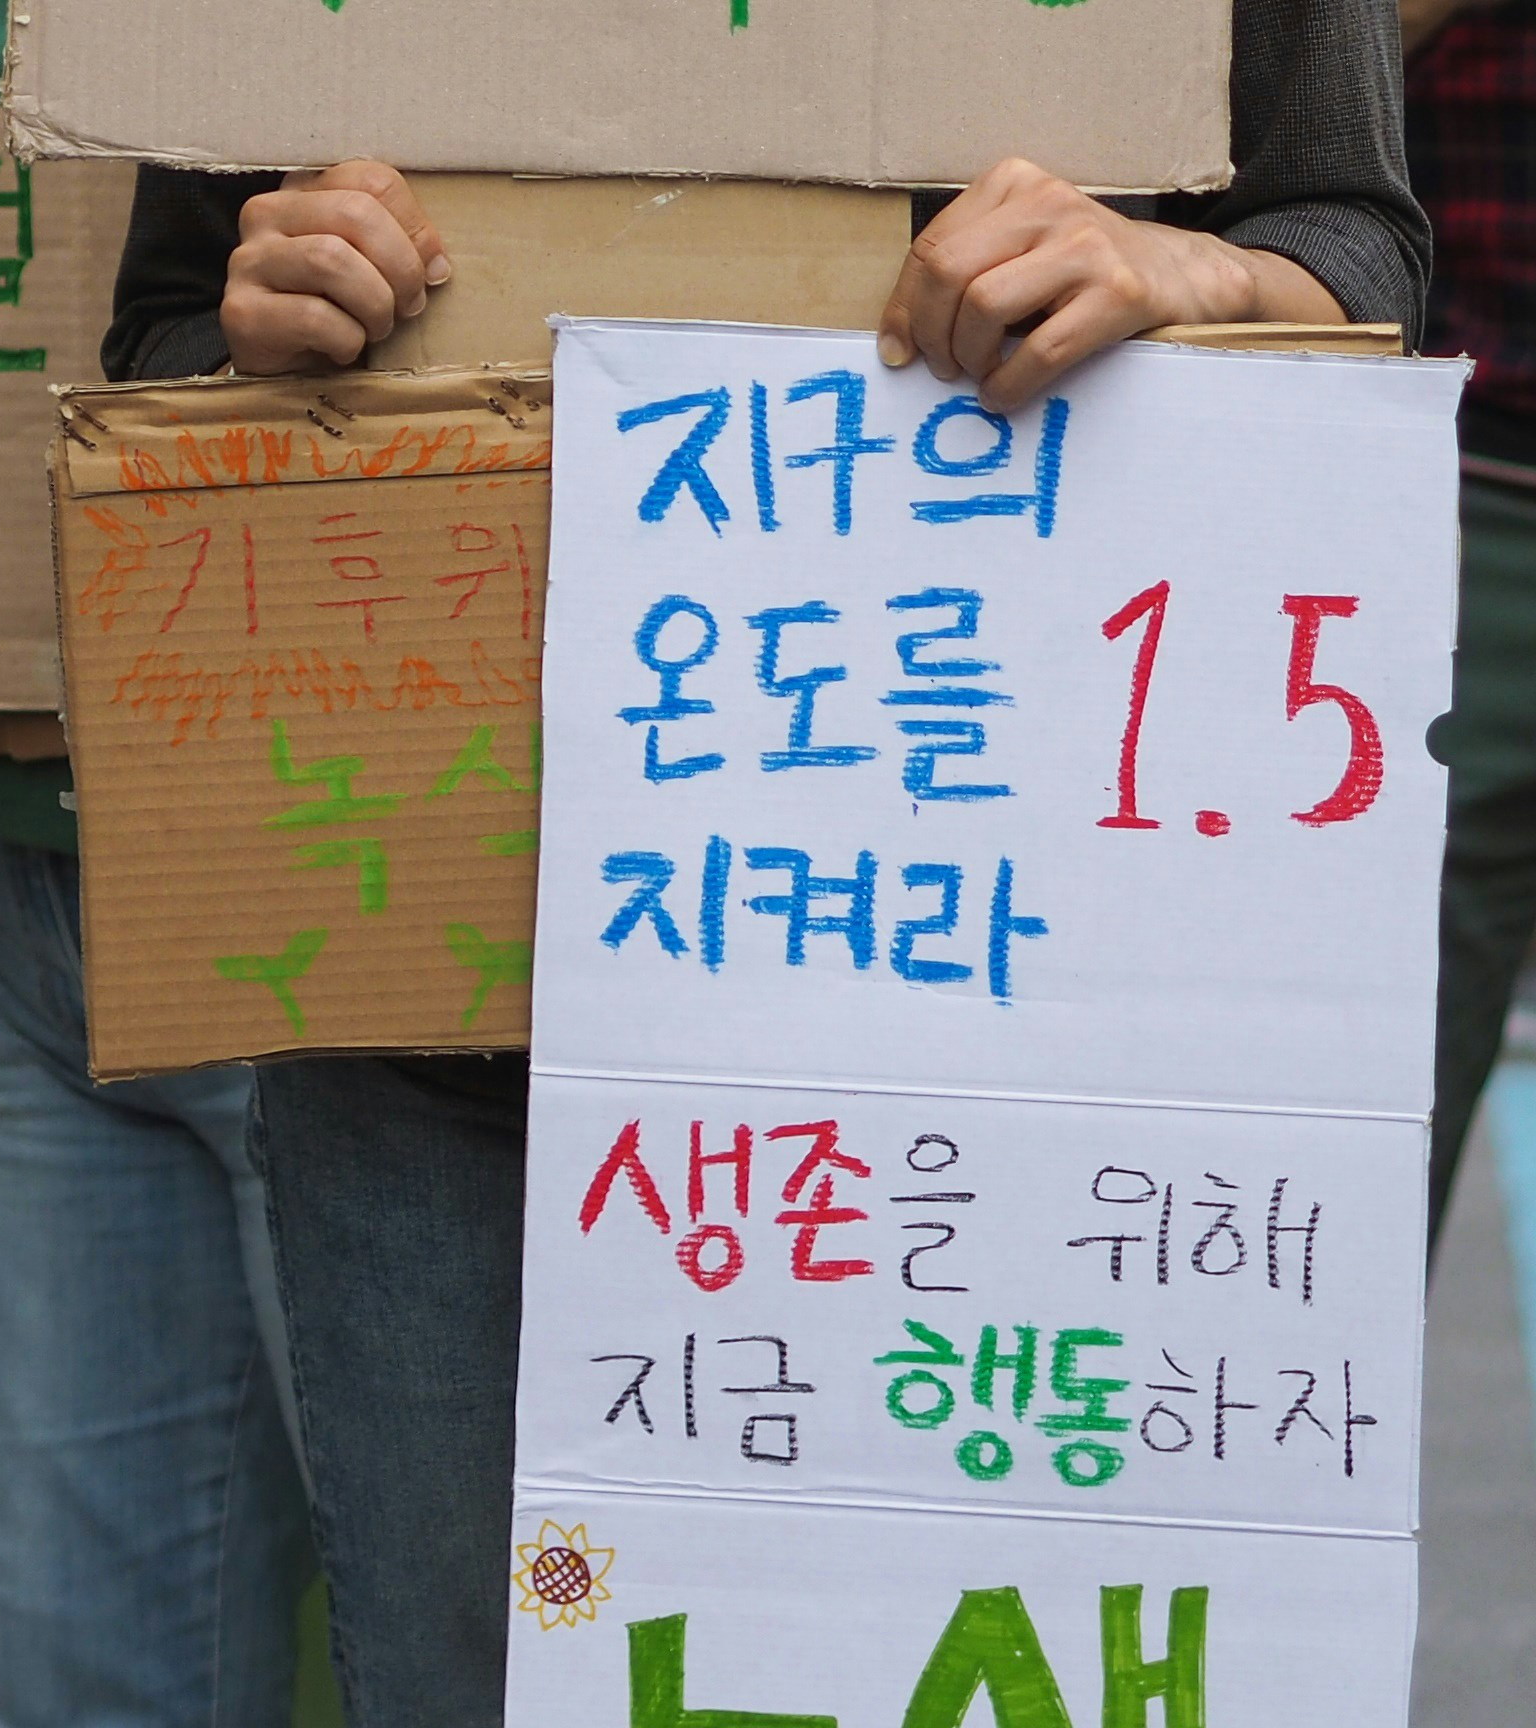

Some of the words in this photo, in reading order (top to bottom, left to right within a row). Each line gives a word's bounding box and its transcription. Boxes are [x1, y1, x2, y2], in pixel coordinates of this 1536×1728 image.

[613, 367, 1072, 540] 지구의
[614, 586, 1020, 801] 온도를
[1093, 578, 1387, 839] 1.5
[598, 833, 1050, 1008] 지켜라
[576, 1118, 978, 1294] 생존을
[1065, 1164, 1323, 1307] 위해
[589, 1332, 818, 1466] 지금
[872, 1318, 1379, 1488] 행동하자
